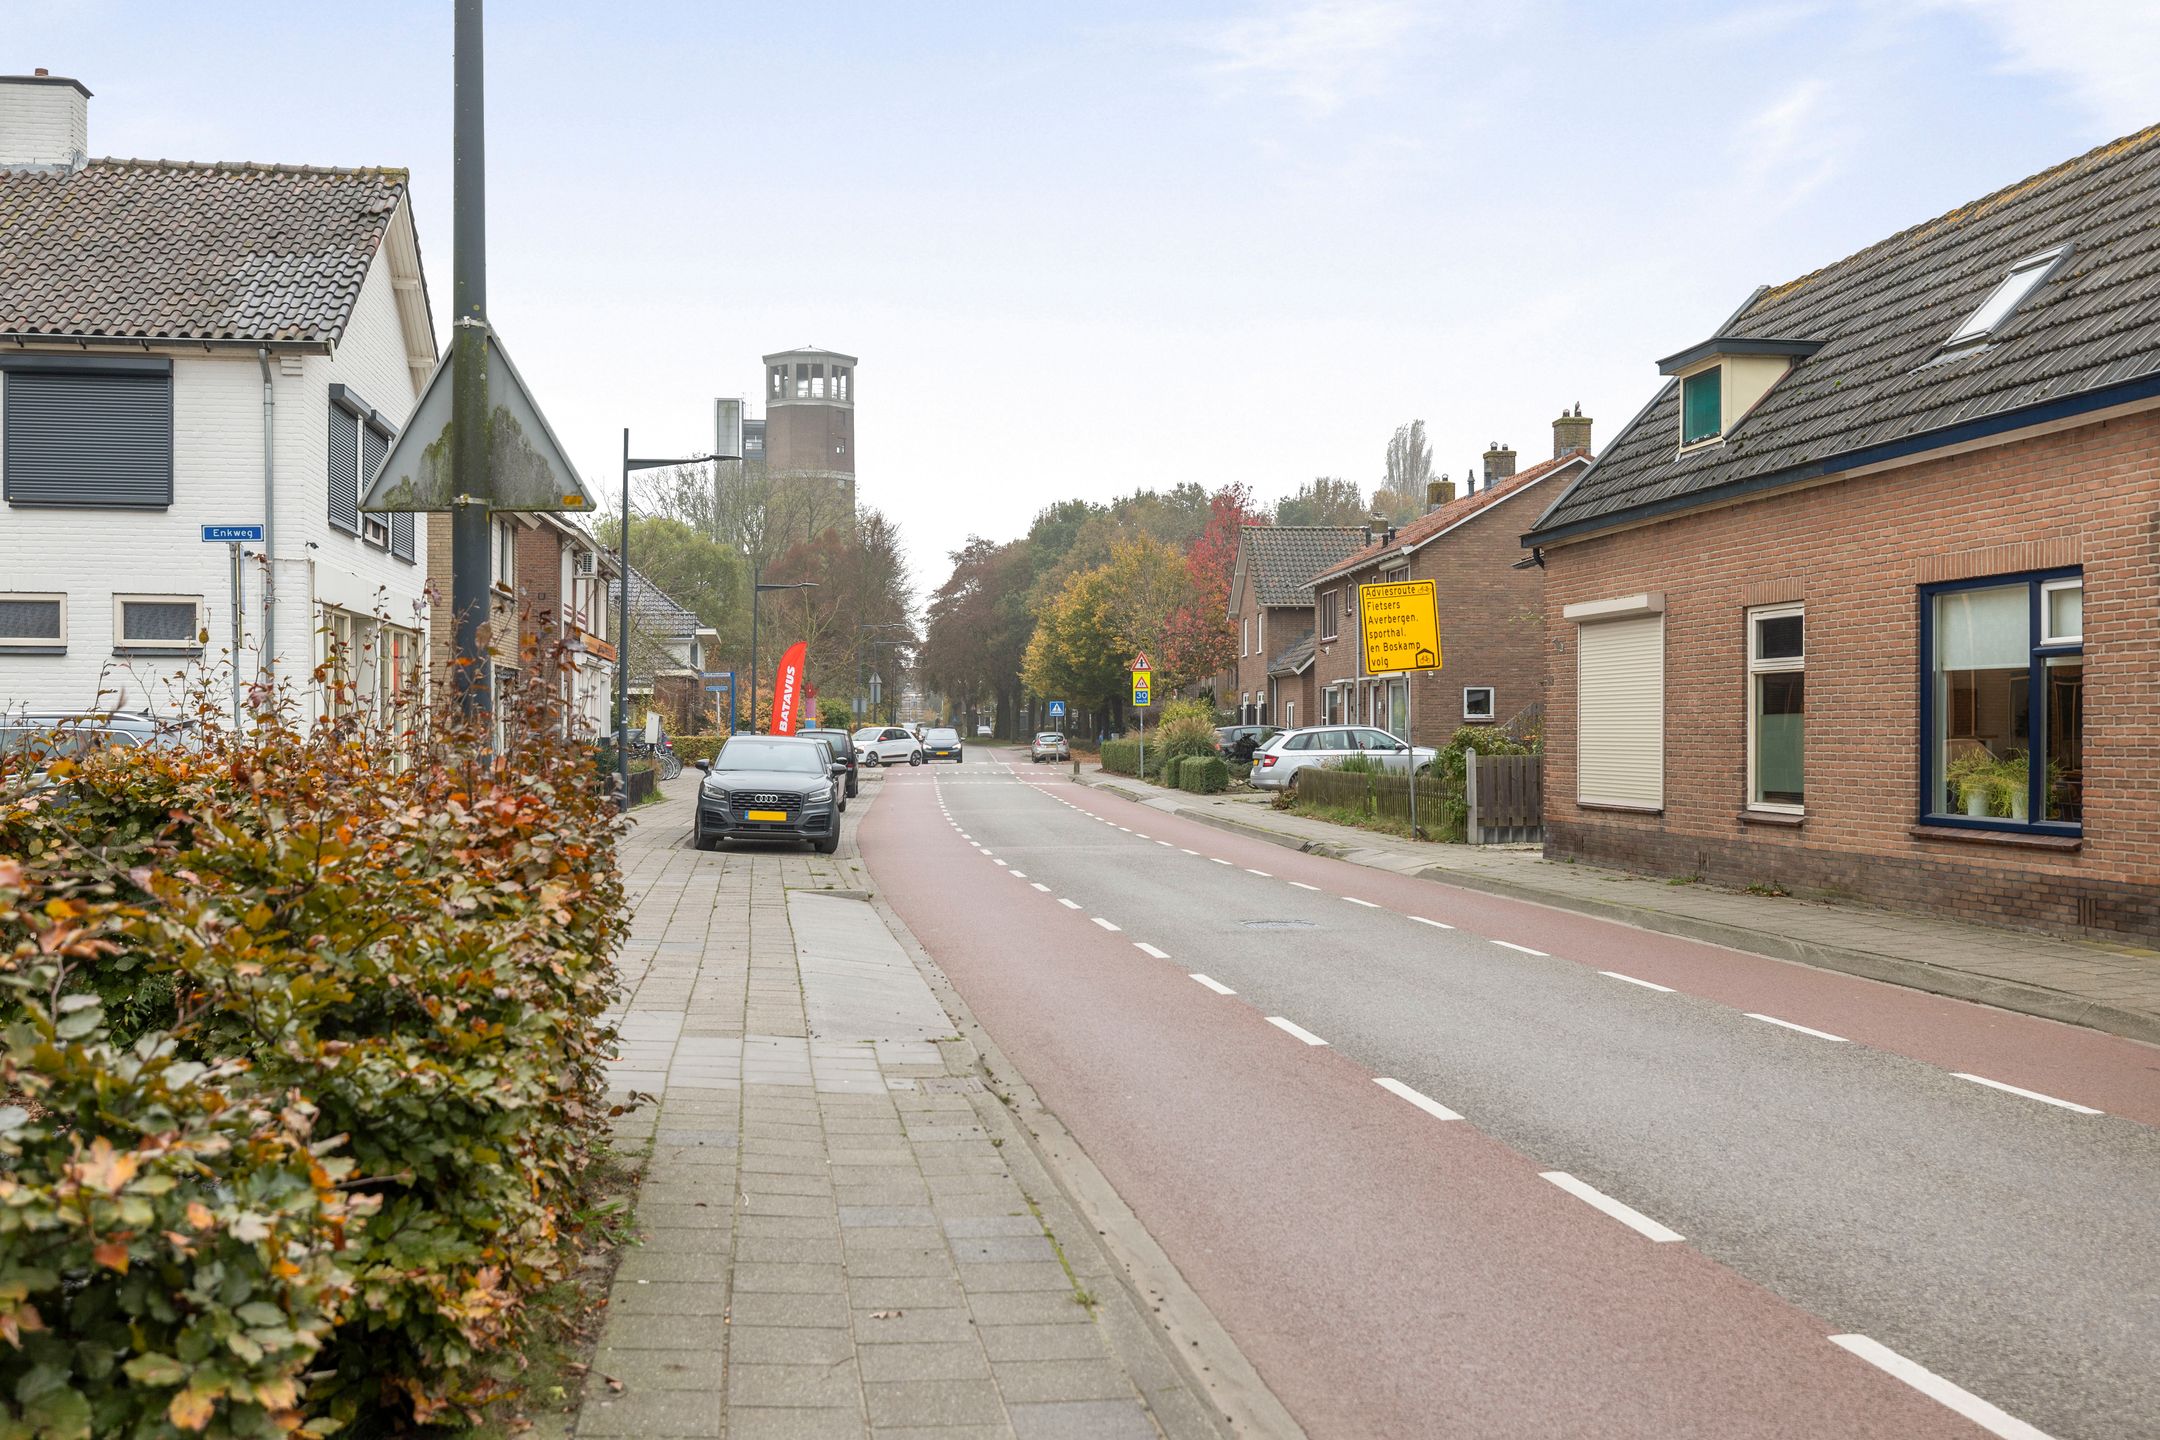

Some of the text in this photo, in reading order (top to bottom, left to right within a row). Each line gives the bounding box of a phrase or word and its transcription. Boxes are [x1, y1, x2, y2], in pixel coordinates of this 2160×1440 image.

[213, 529, 253, 538] Enkweg
[1366, 586, 1416, 597] Adviesroute
[1367, 601, 1401, 611] Fietsers
[1370, 641, 1421, 653] en Boskamp
[1372, 657, 1389, 668] volg
[779, 665, 795, 732] BATAVUS
